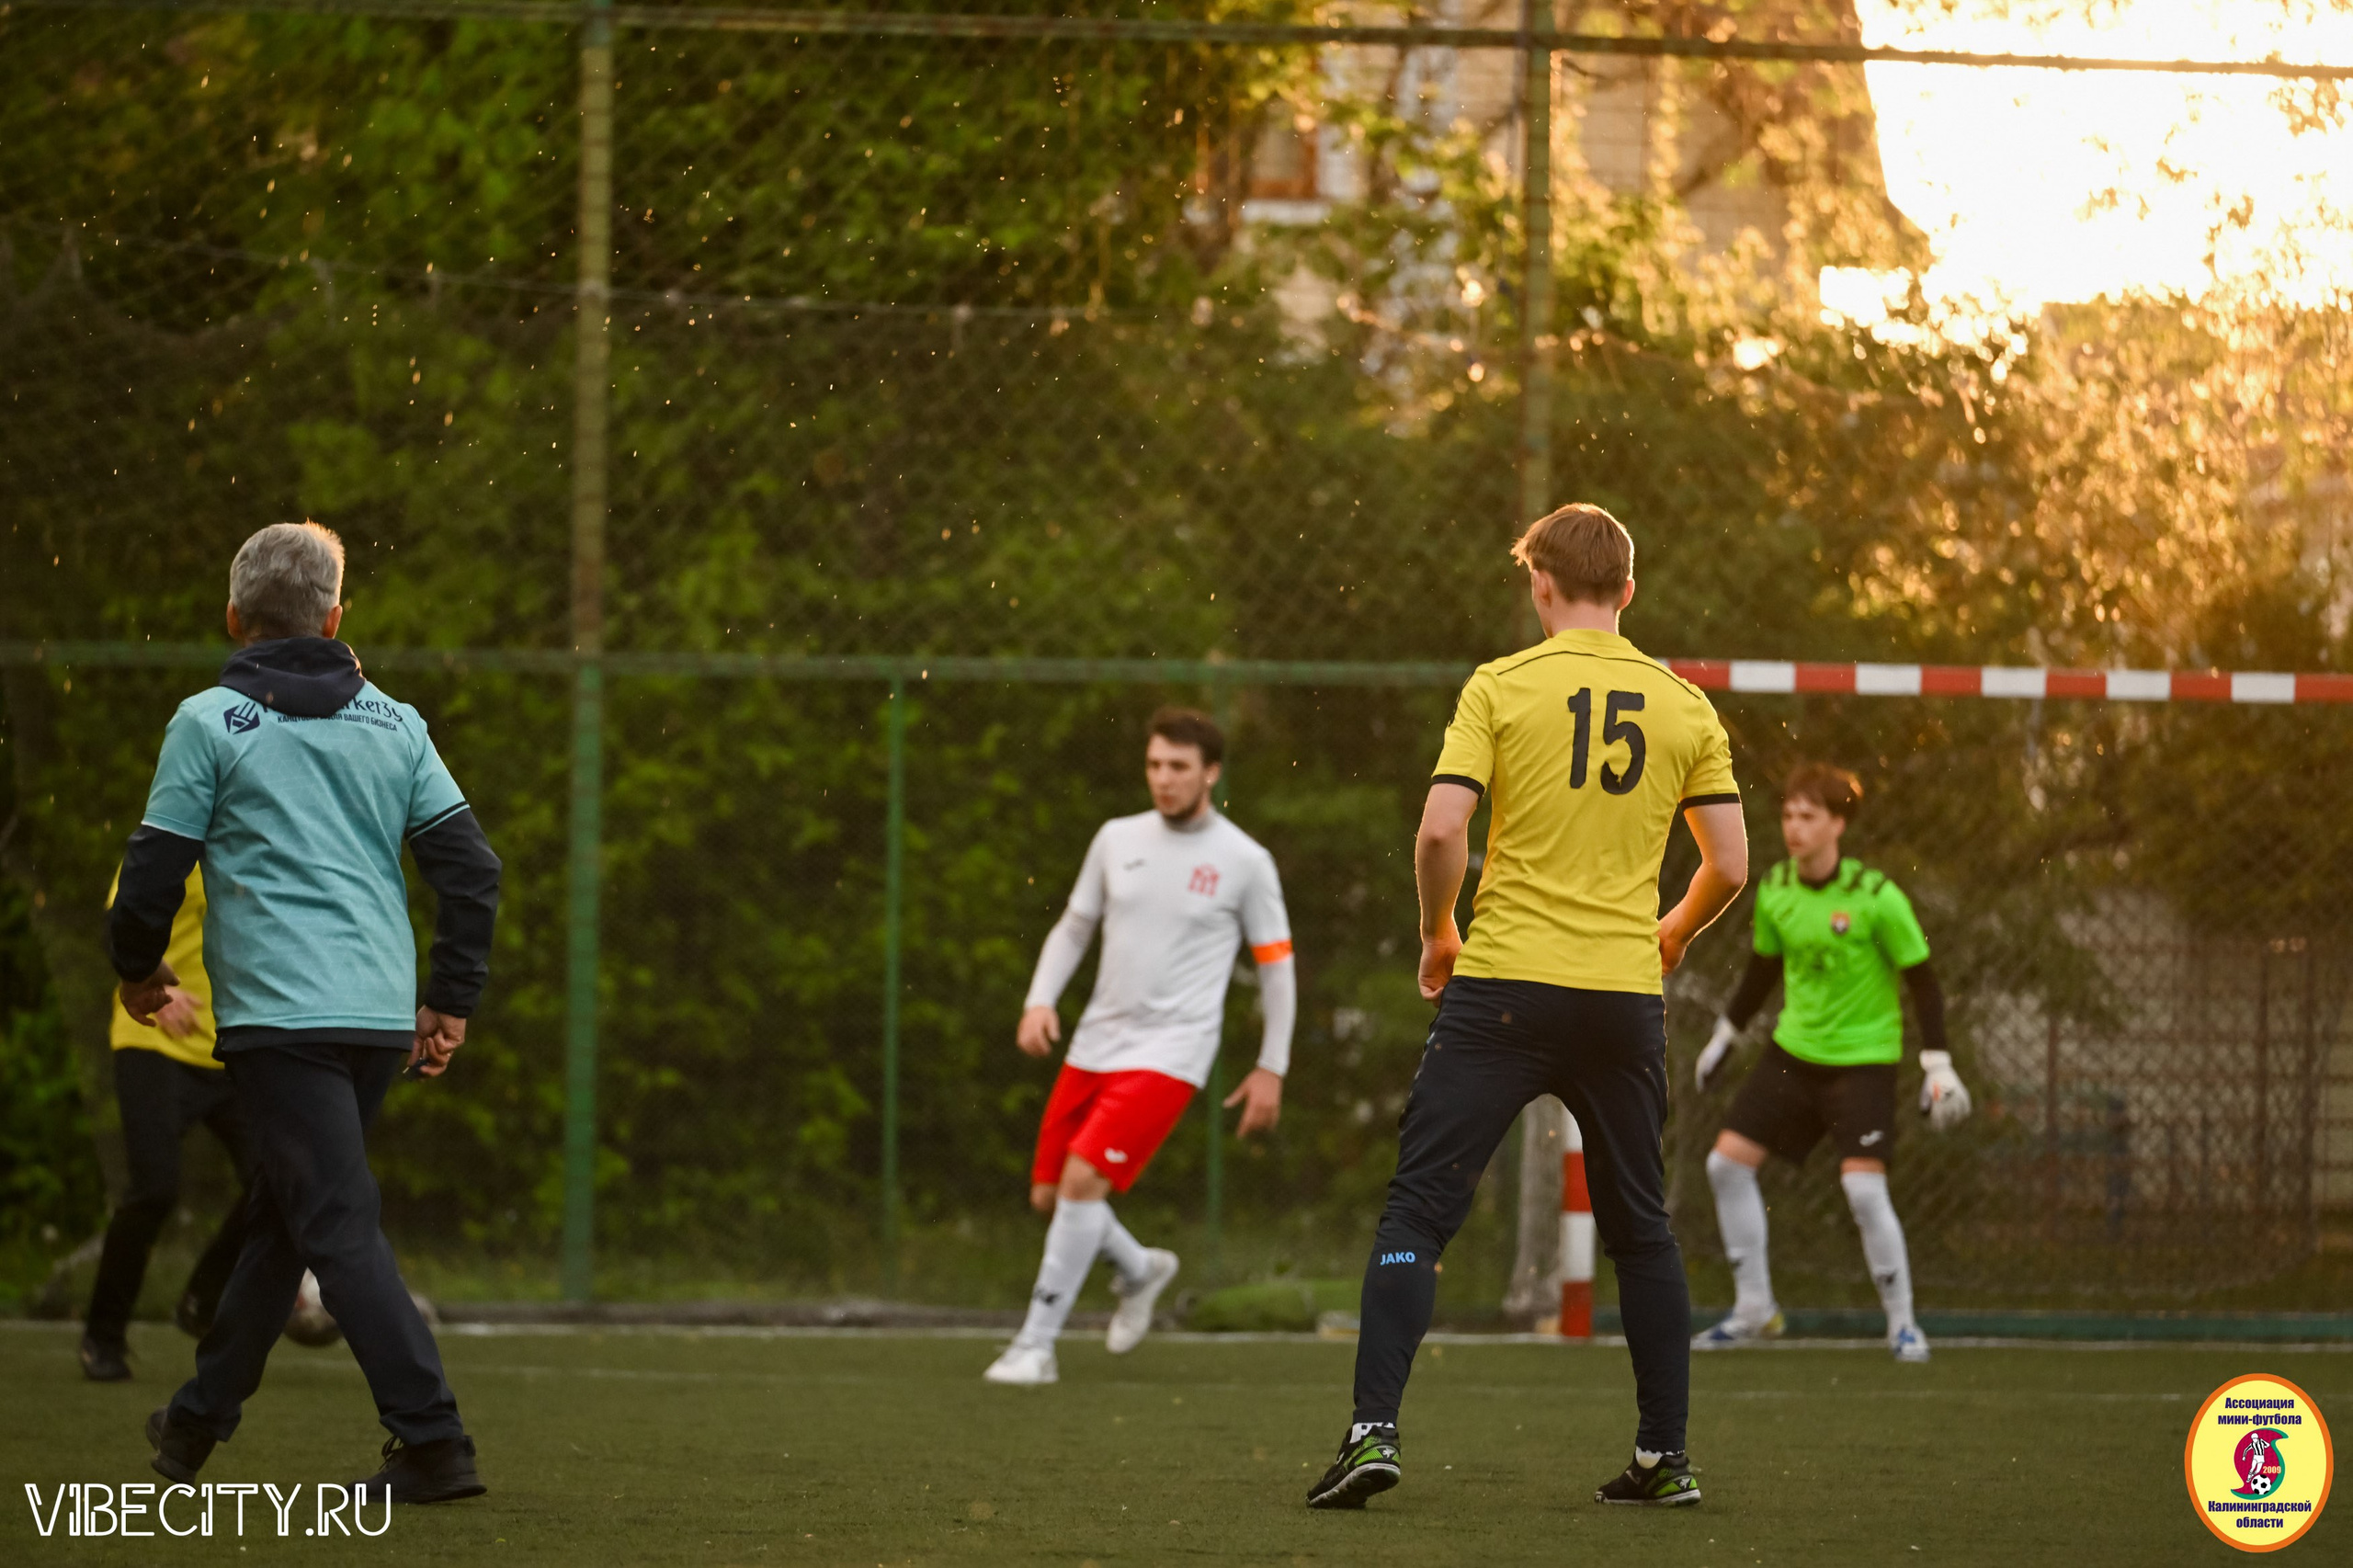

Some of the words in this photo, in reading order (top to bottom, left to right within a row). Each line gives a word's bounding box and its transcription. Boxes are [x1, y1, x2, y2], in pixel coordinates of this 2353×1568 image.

[344, 713, 369, 724] ВАШЕГО
[370, 717, 398, 733] БИЗНЕСА
[1567, 687, 1646, 795] 15
[1380, 1251, 1415, 1266] JAKO
